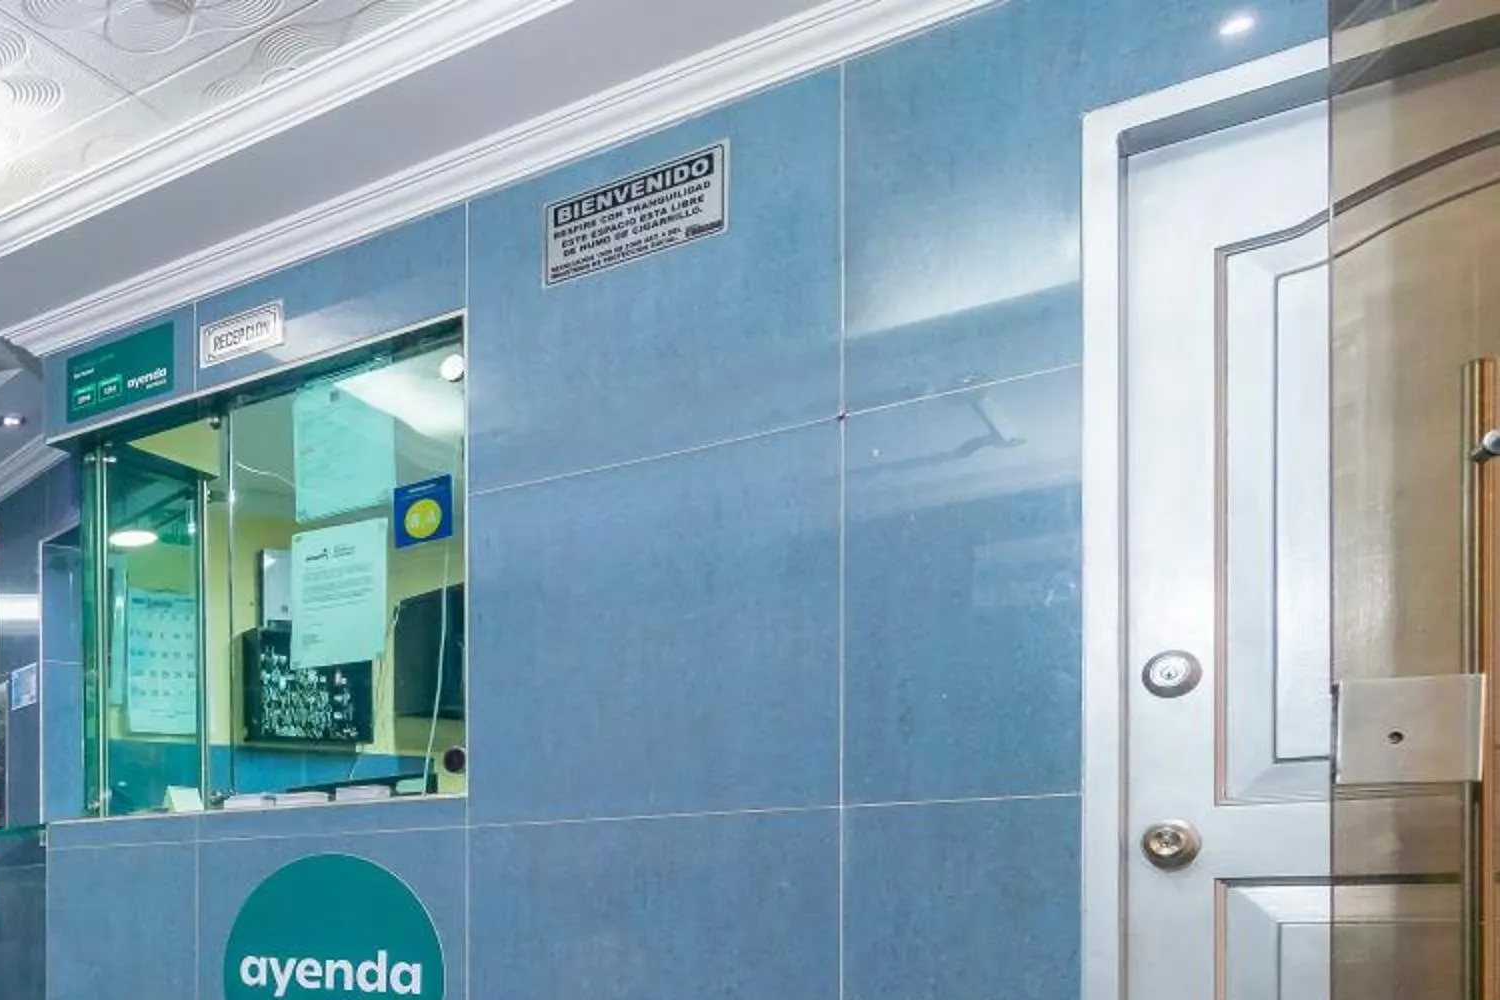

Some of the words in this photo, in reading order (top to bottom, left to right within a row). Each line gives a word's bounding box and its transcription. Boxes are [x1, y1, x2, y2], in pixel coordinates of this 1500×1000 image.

[553, 220, 597, 240] RESPIRE
[600, 211, 624, 224] CON
[627, 180, 711, 219] TRANQUILIDAD
[556, 156, 710, 226] BIENVENIDO
[561, 232, 588, 249] ESTE
[590, 217, 637, 243] ESPACIO
[639, 207, 668, 223] ESTA
[671, 194, 705, 214] LIBRE
[563, 246, 577, 257] DE
[579, 234, 611, 253] HUMO
[239, 950, 422, 998] ayenda
